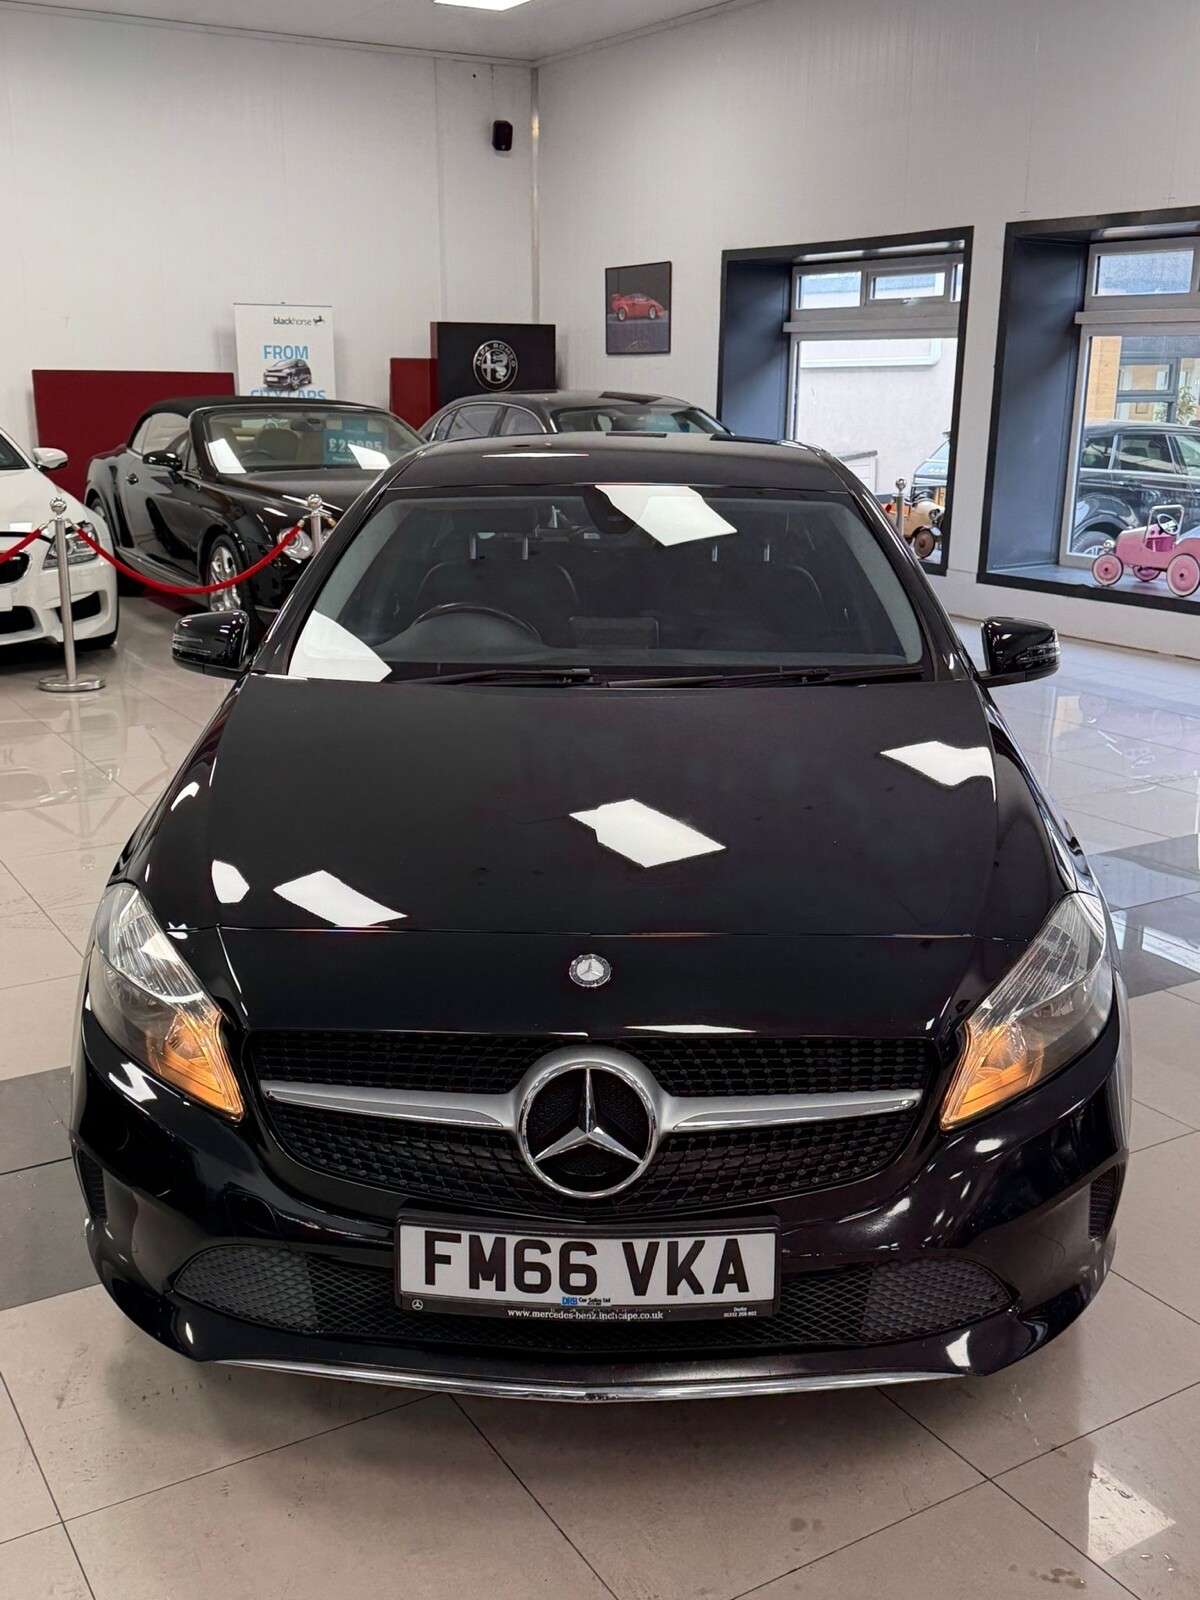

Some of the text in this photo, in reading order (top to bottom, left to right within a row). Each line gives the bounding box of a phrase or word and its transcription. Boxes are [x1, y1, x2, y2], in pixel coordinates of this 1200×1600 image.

[273, 316, 312, 326] blackhorse
[263, 345, 309, 360] FROM
[476, 343, 516, 368] ALFA ROMEO
[424, 1230, 750, 1296] FM66 VKA
[507, 1308, 664, 1321] www.mercedes-benz.inchcape.co.uk
